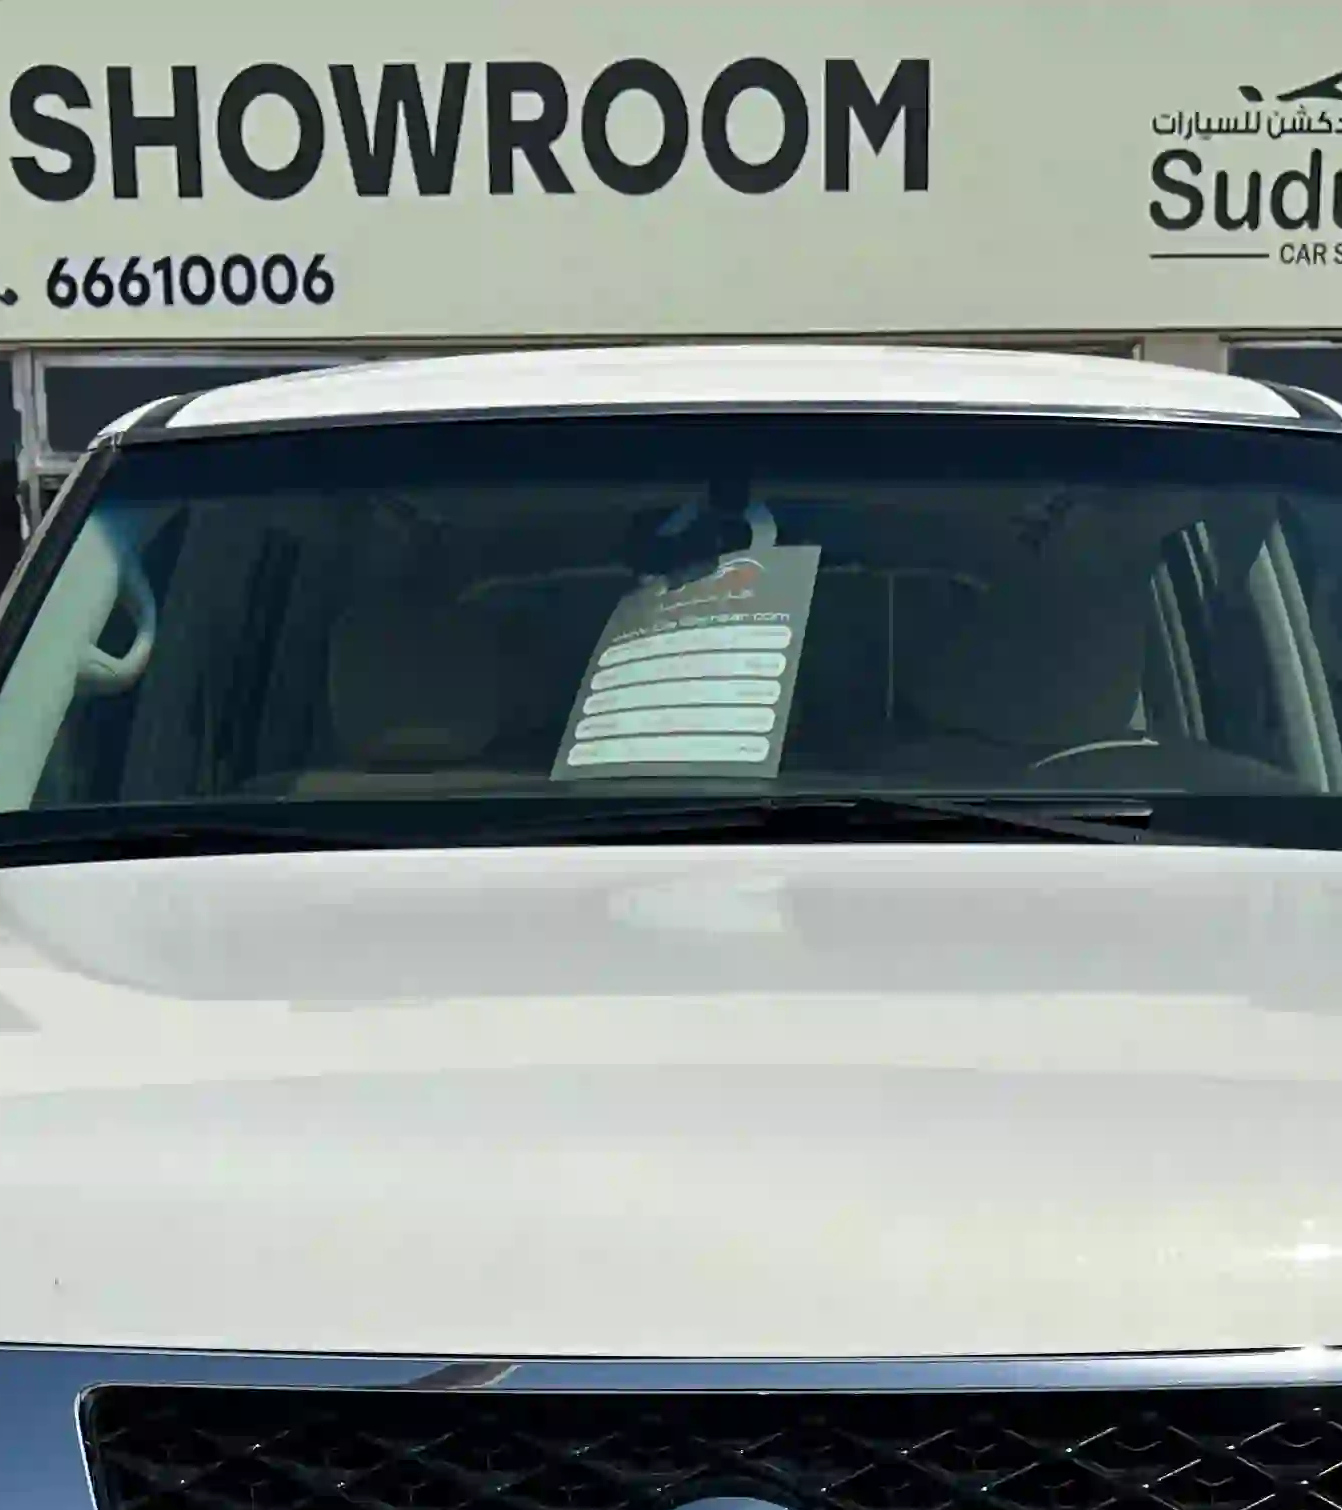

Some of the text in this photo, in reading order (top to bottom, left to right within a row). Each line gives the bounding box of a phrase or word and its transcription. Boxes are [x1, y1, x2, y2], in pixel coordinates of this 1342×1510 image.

[9, 57, 930, 201] SHOWROOM
[1151, 110, 1262, 140] للسيارات
[1279, 242, 1328, 266] CAR
[46, 253, 335, 309] 66610006
